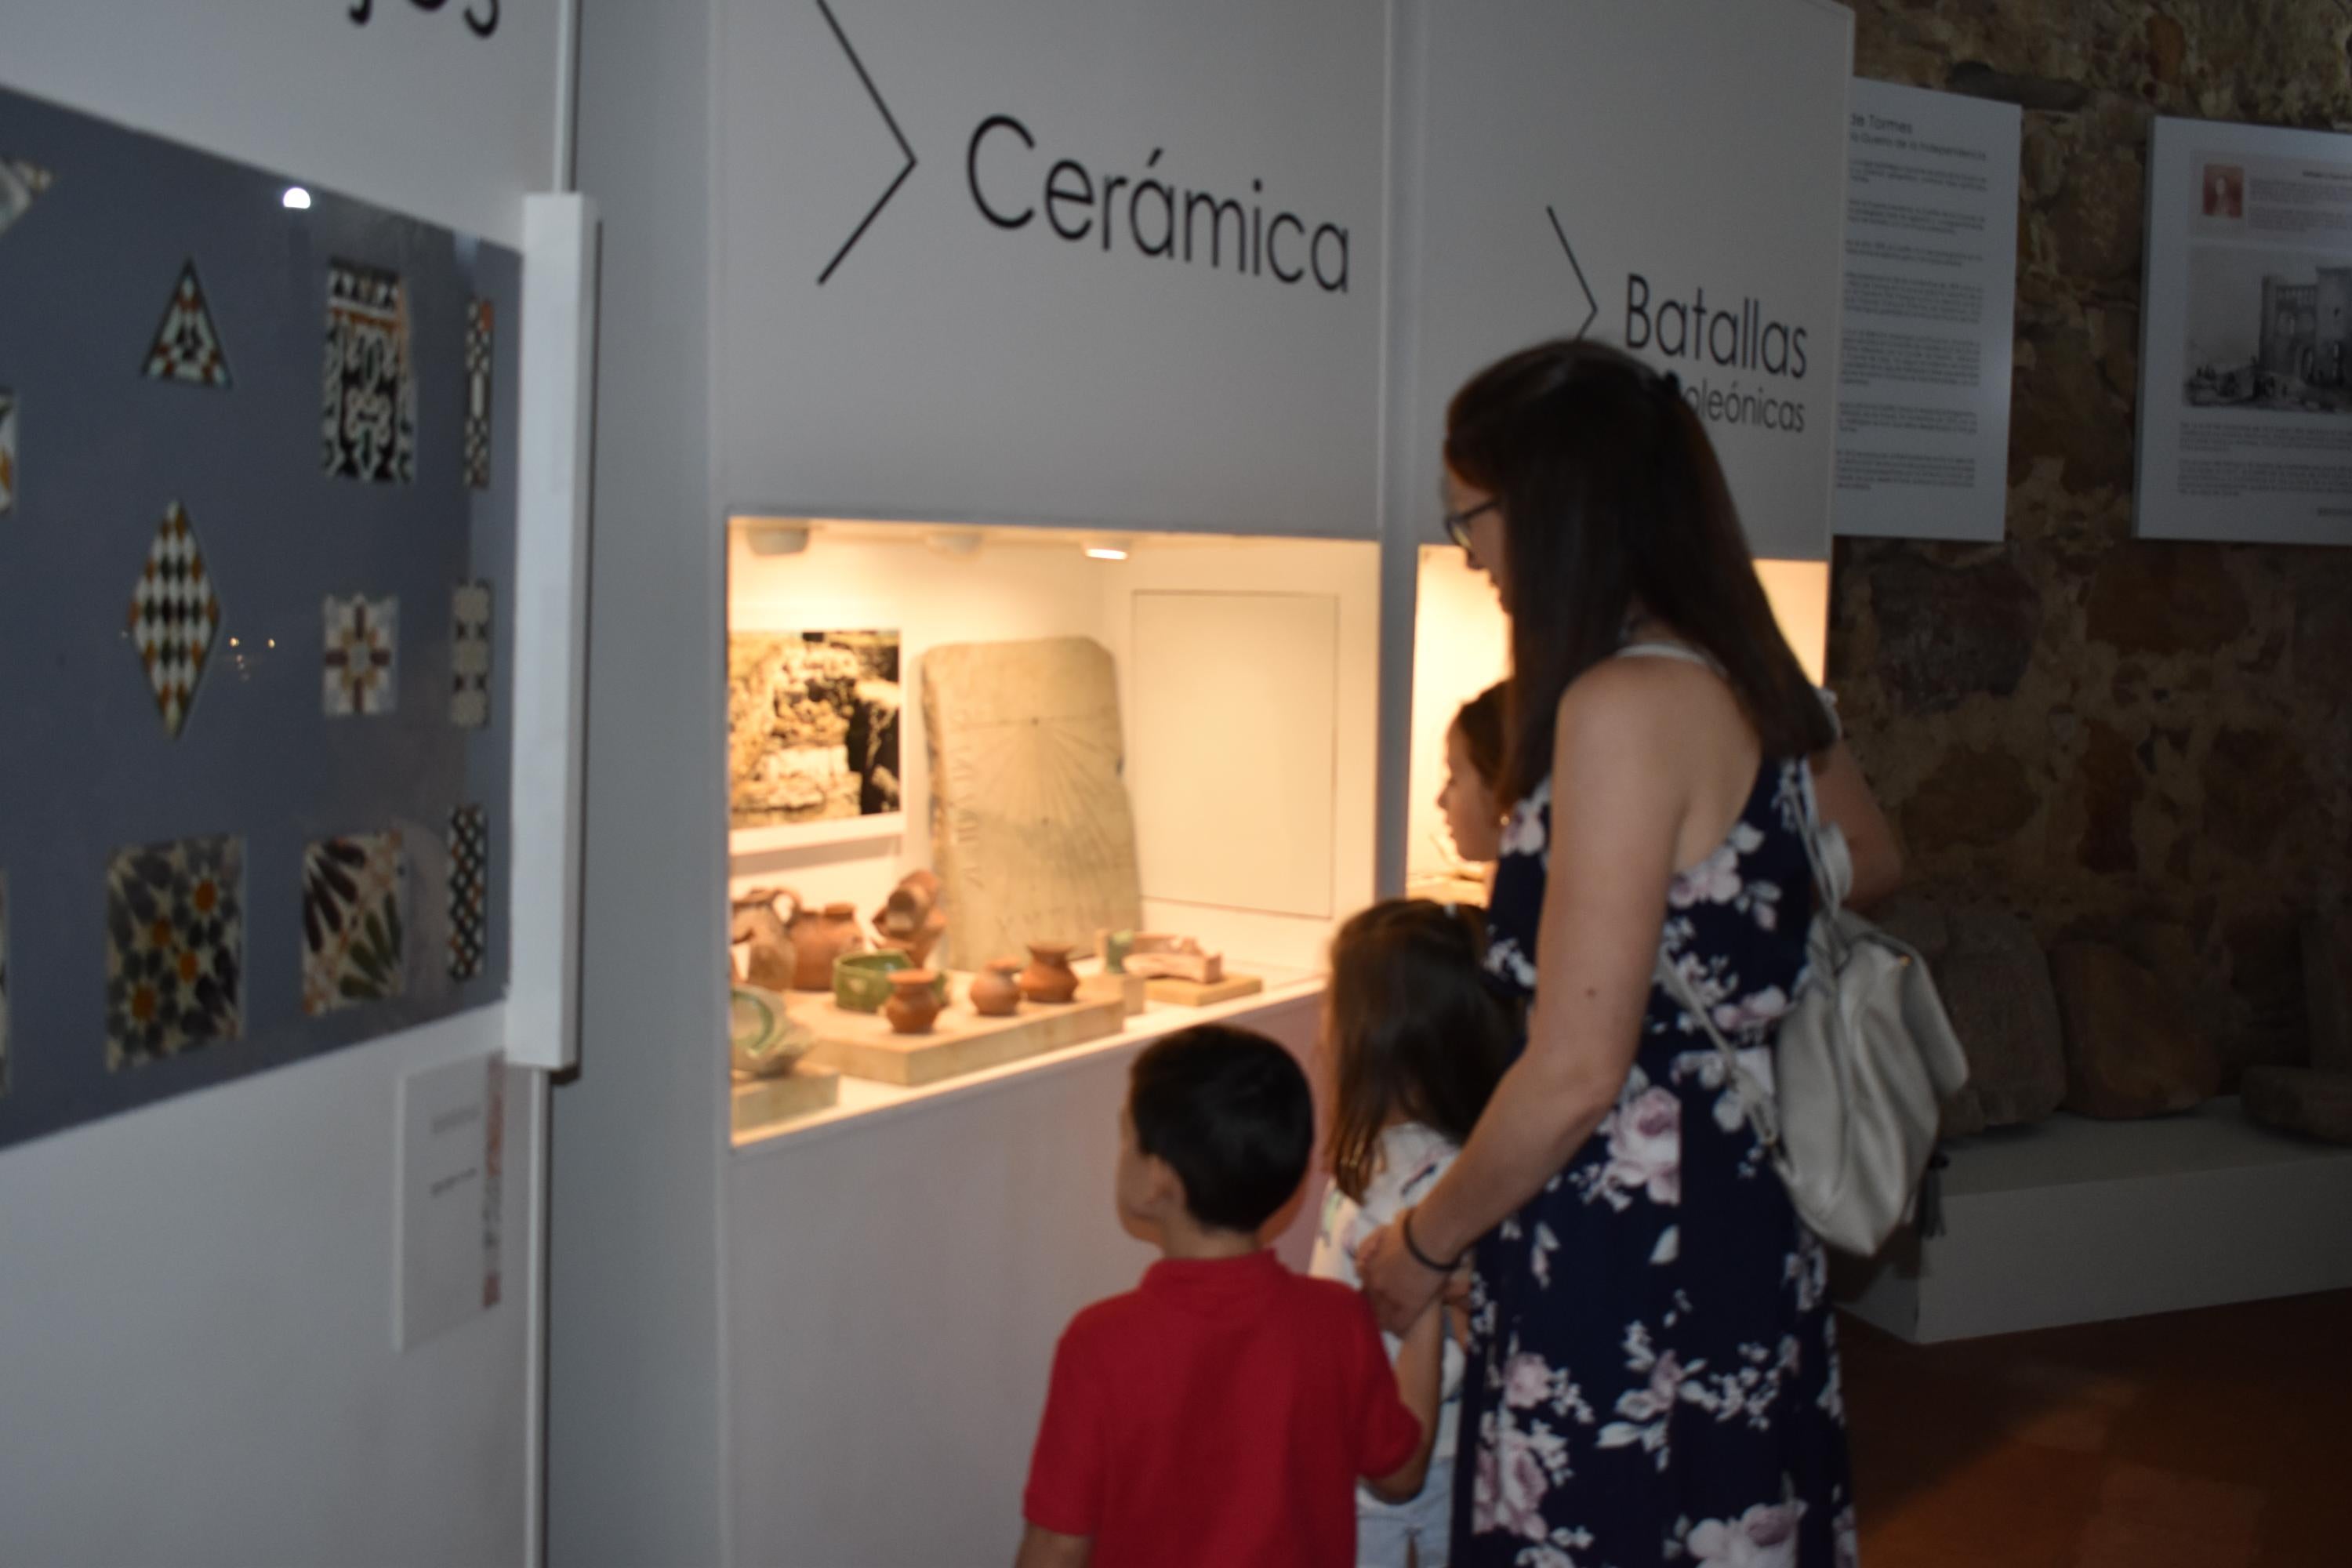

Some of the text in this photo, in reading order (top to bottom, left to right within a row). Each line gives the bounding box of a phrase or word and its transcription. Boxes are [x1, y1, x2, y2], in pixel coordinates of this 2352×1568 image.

[966, 114, 1350, 294] Cerámica
[1626, 273, 1808, 379] Batallas
[1683, 379, 1806, 433] oleónicas
